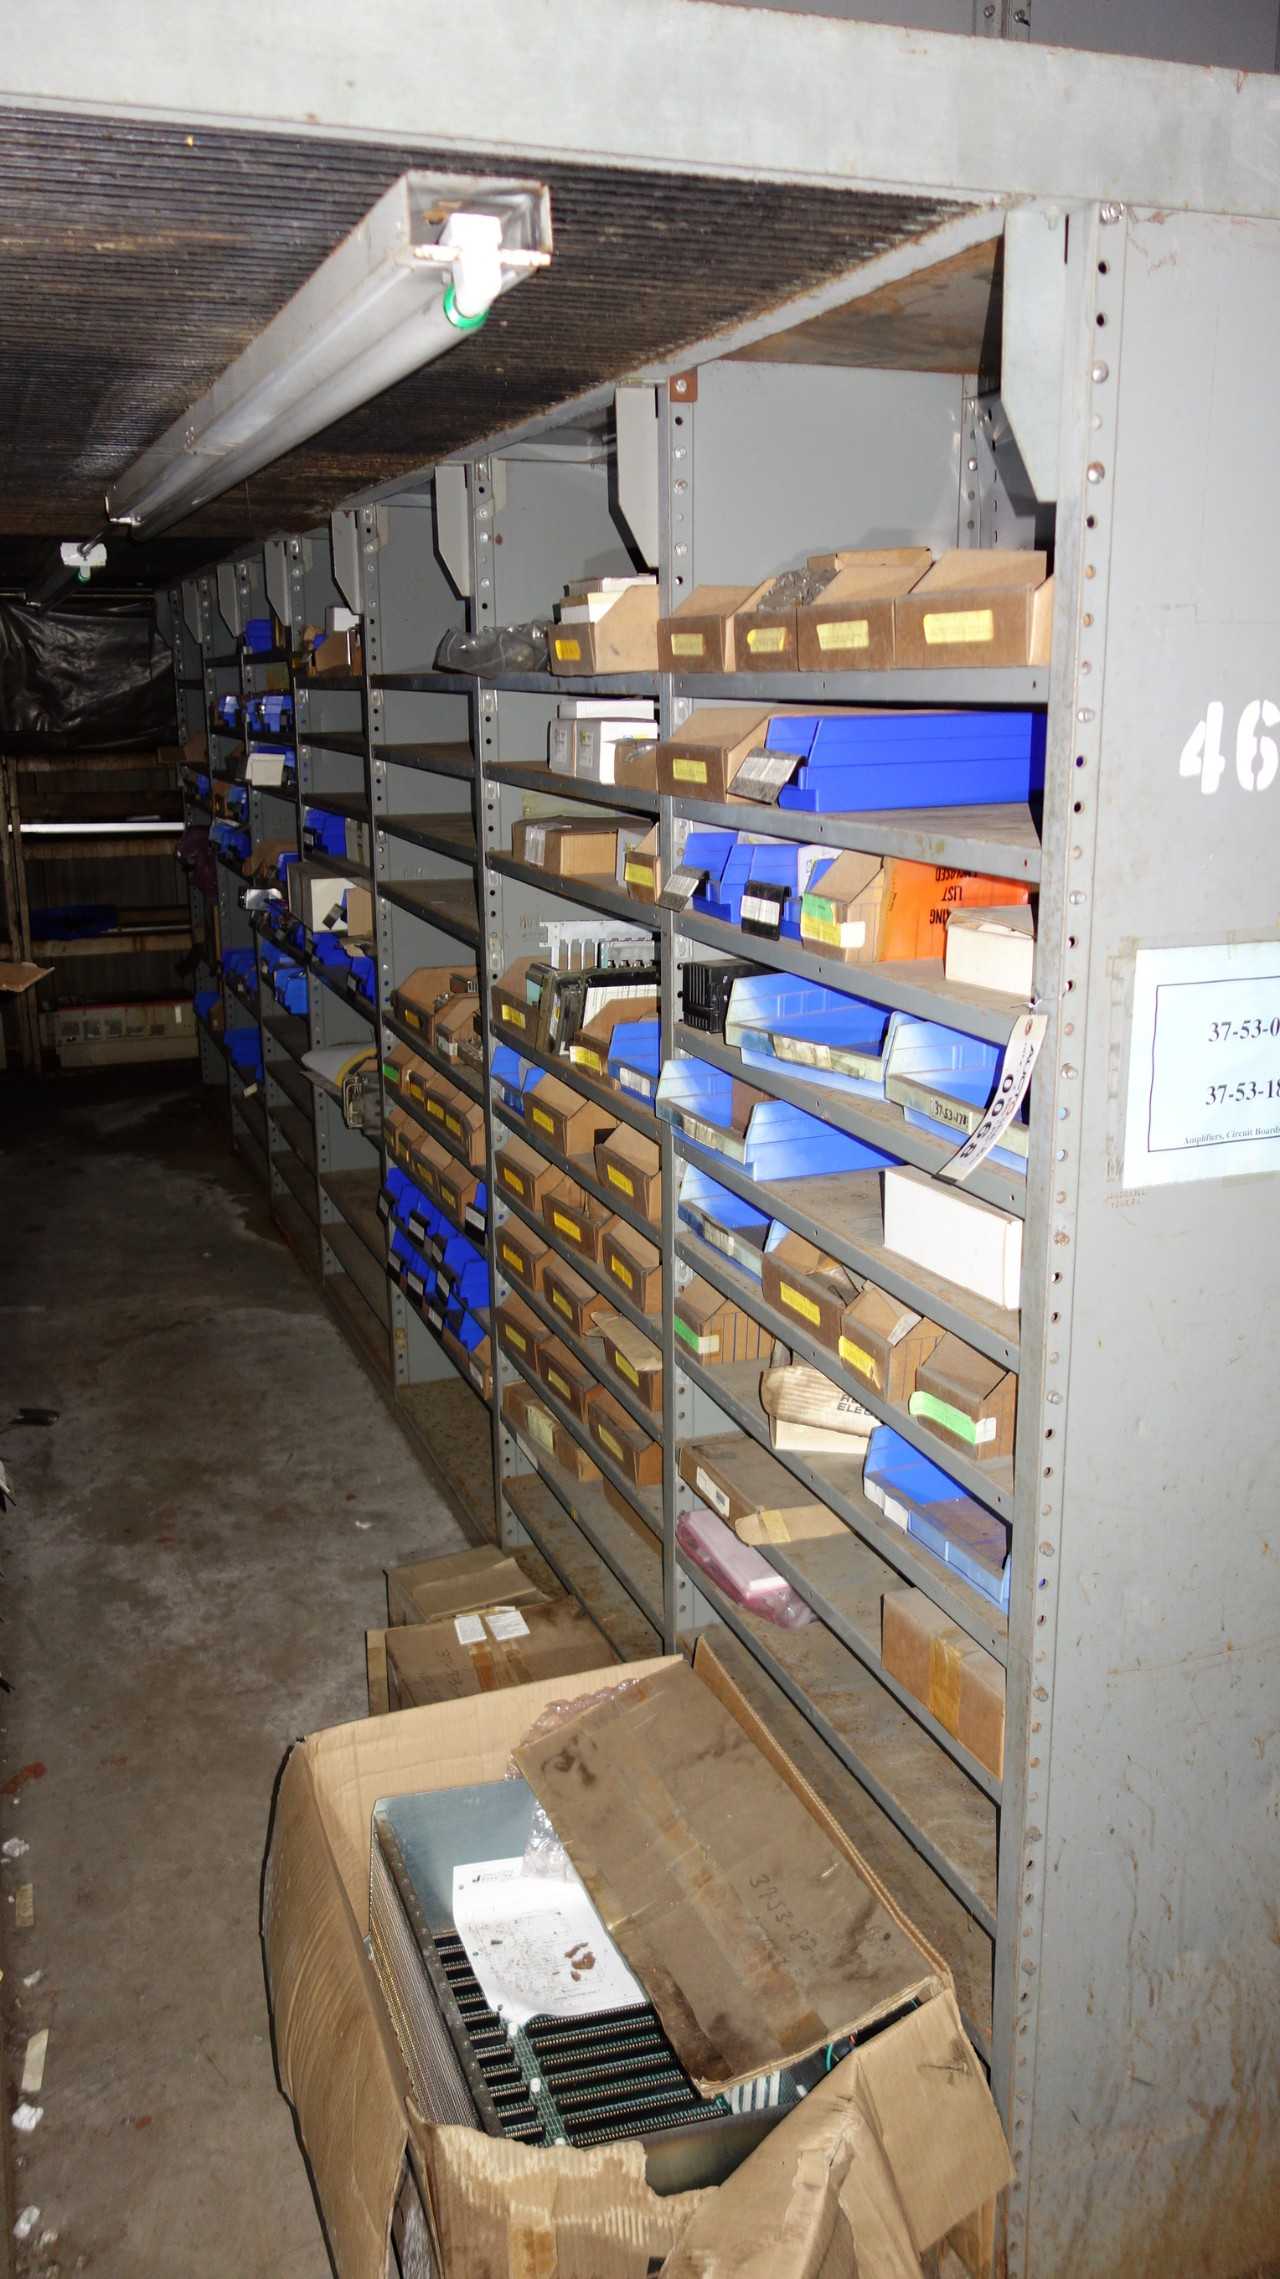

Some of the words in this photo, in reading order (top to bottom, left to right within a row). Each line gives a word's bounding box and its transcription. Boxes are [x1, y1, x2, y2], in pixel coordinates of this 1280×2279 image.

[1179, 699, 1280, 795] 46
[941, 885, 963, 902] LIST
[1208, 1016, 1280, 1042] 37-53-0
[1225, 1126, 1254, 1138] Circuit
